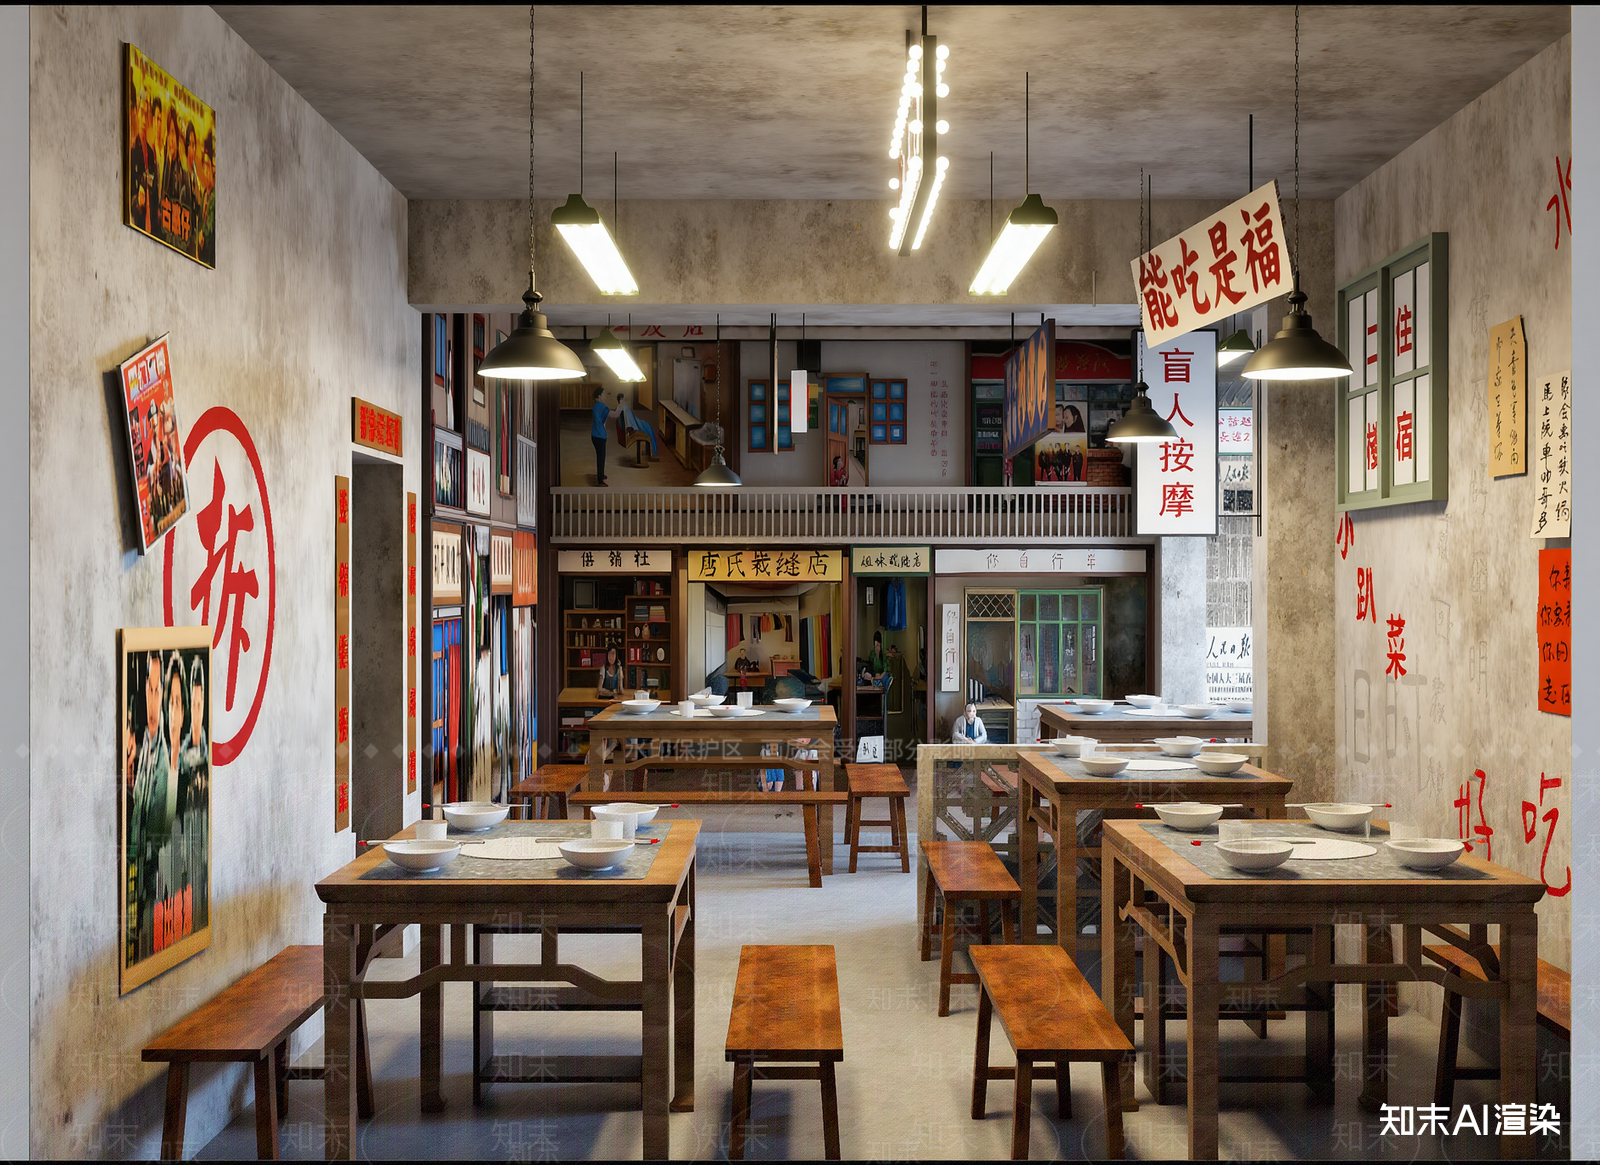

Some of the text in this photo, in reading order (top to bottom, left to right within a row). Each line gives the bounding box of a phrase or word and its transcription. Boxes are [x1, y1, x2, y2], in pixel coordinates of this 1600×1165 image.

[1138, 202, 1282, 331] 能吃是福
[1158, 347, 1195, 519] 盲人按摩
[1396, 304, 1413, 462] 住宿
[190, 456, 260, 712] 拆
[1336, 511, 1407, 680] 小趴菜
[1453, 769, 1571, 897] 好吃
